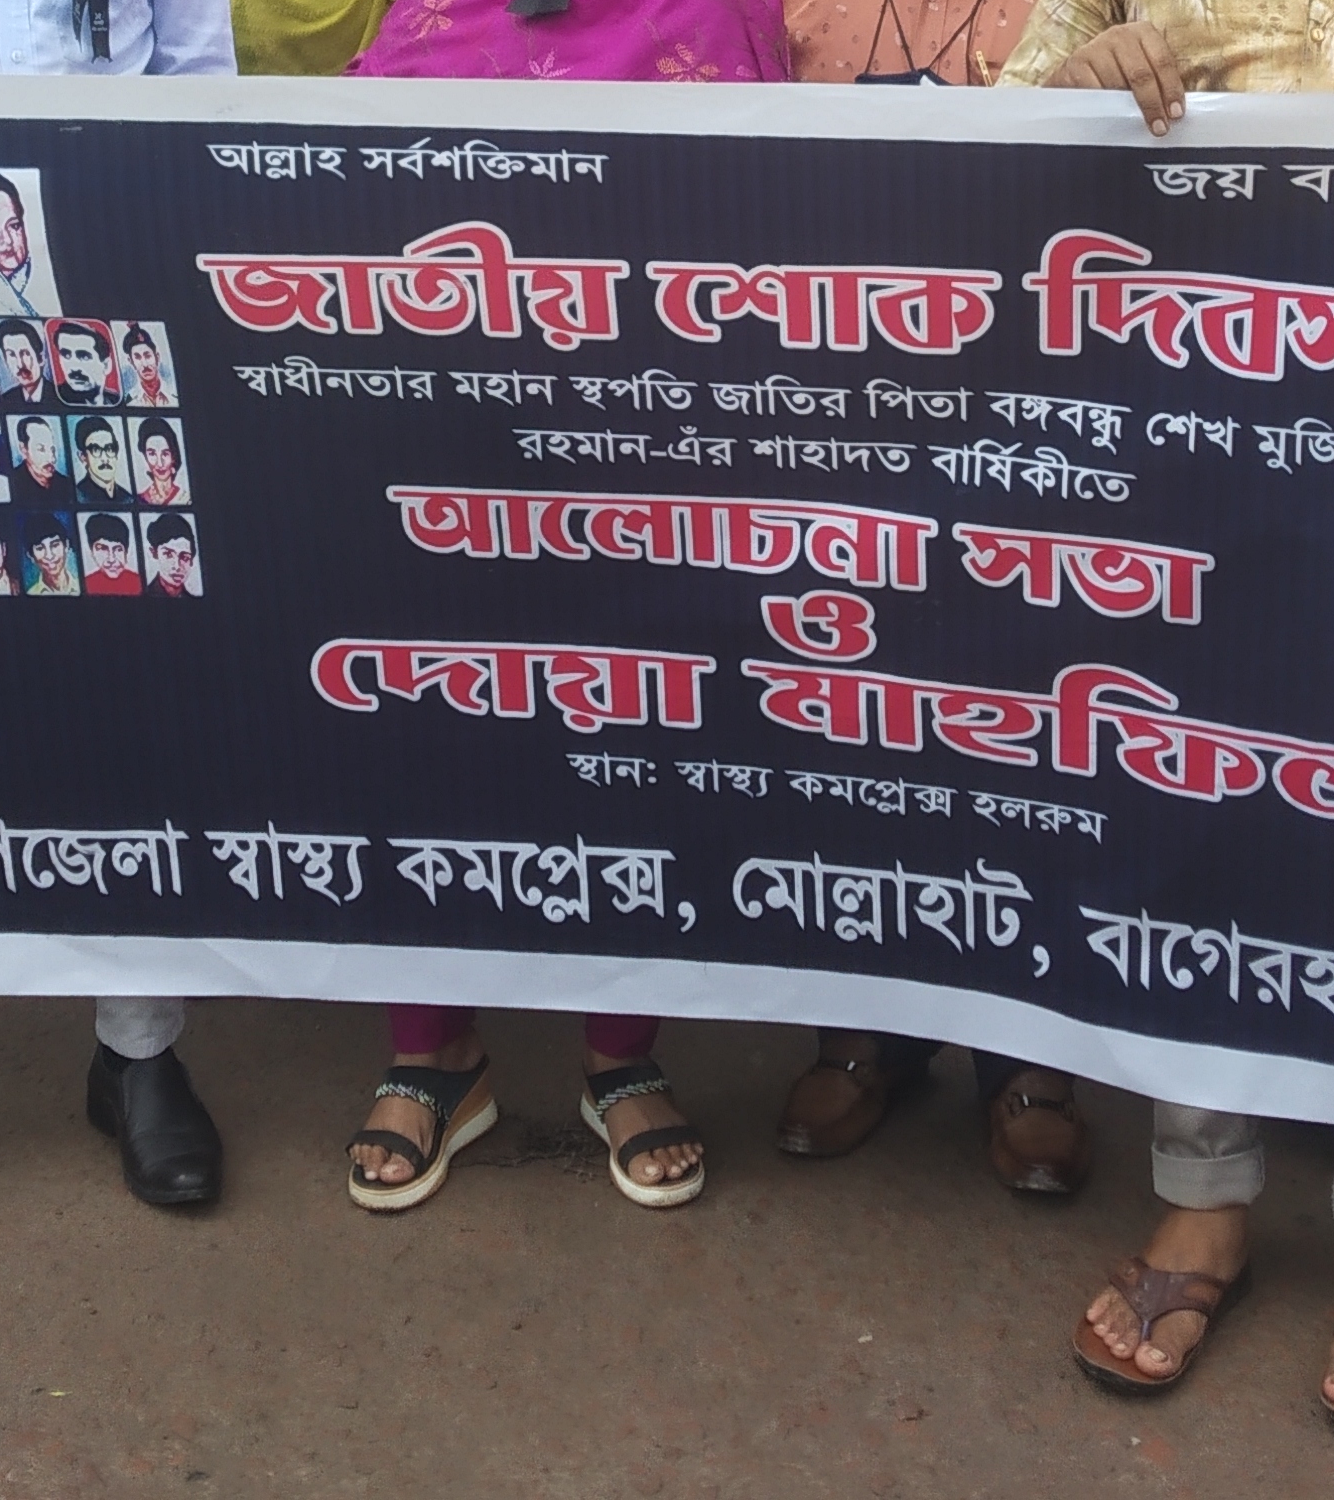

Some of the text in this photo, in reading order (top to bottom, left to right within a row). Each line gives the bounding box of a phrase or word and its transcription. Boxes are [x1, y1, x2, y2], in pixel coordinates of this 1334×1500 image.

[207, 136, 610, 184] আল্লাহ সর্বশক্তিমান
[1143, 163, 1268, 201] জয়
[195, 220, 630, 352] জাতীয়
[645, 260, 1003, 356] শোক
[232, 355, 437, 402] স্বাধীনতার
[447, 367, 558, 406] মহান
[568, 367, 698, 412] স্থপতি
[708, 375, 852, 418] জাতির
[863, 377, 975, 422] পিতা
[983, 389, 1132, 456] বঙ্গবন্ধু
[1145, 409, 1242, 457] শেখ
[511, 426, 1137, 503] রহমান-এঁর শাহাদত বার্ষিকীতে
[385, 484, 1216, 626] আলোচনা সভা
[760, 588, 877, 662] ও
[310, 637, 717, 734] দোয়া
[673, 759, 775, 799] স্বাস্থ্য
[784, 766, 959, 820] কমপ্লেক্স
[969, 787, 1109, 844] হলরুম
[203, 820, 371, 907] স্বাস্থ্য
[386, 833, 699, 933] কমপ্লেক্স,
[732, 850, 1052, 979] মোল্লাহাট,
